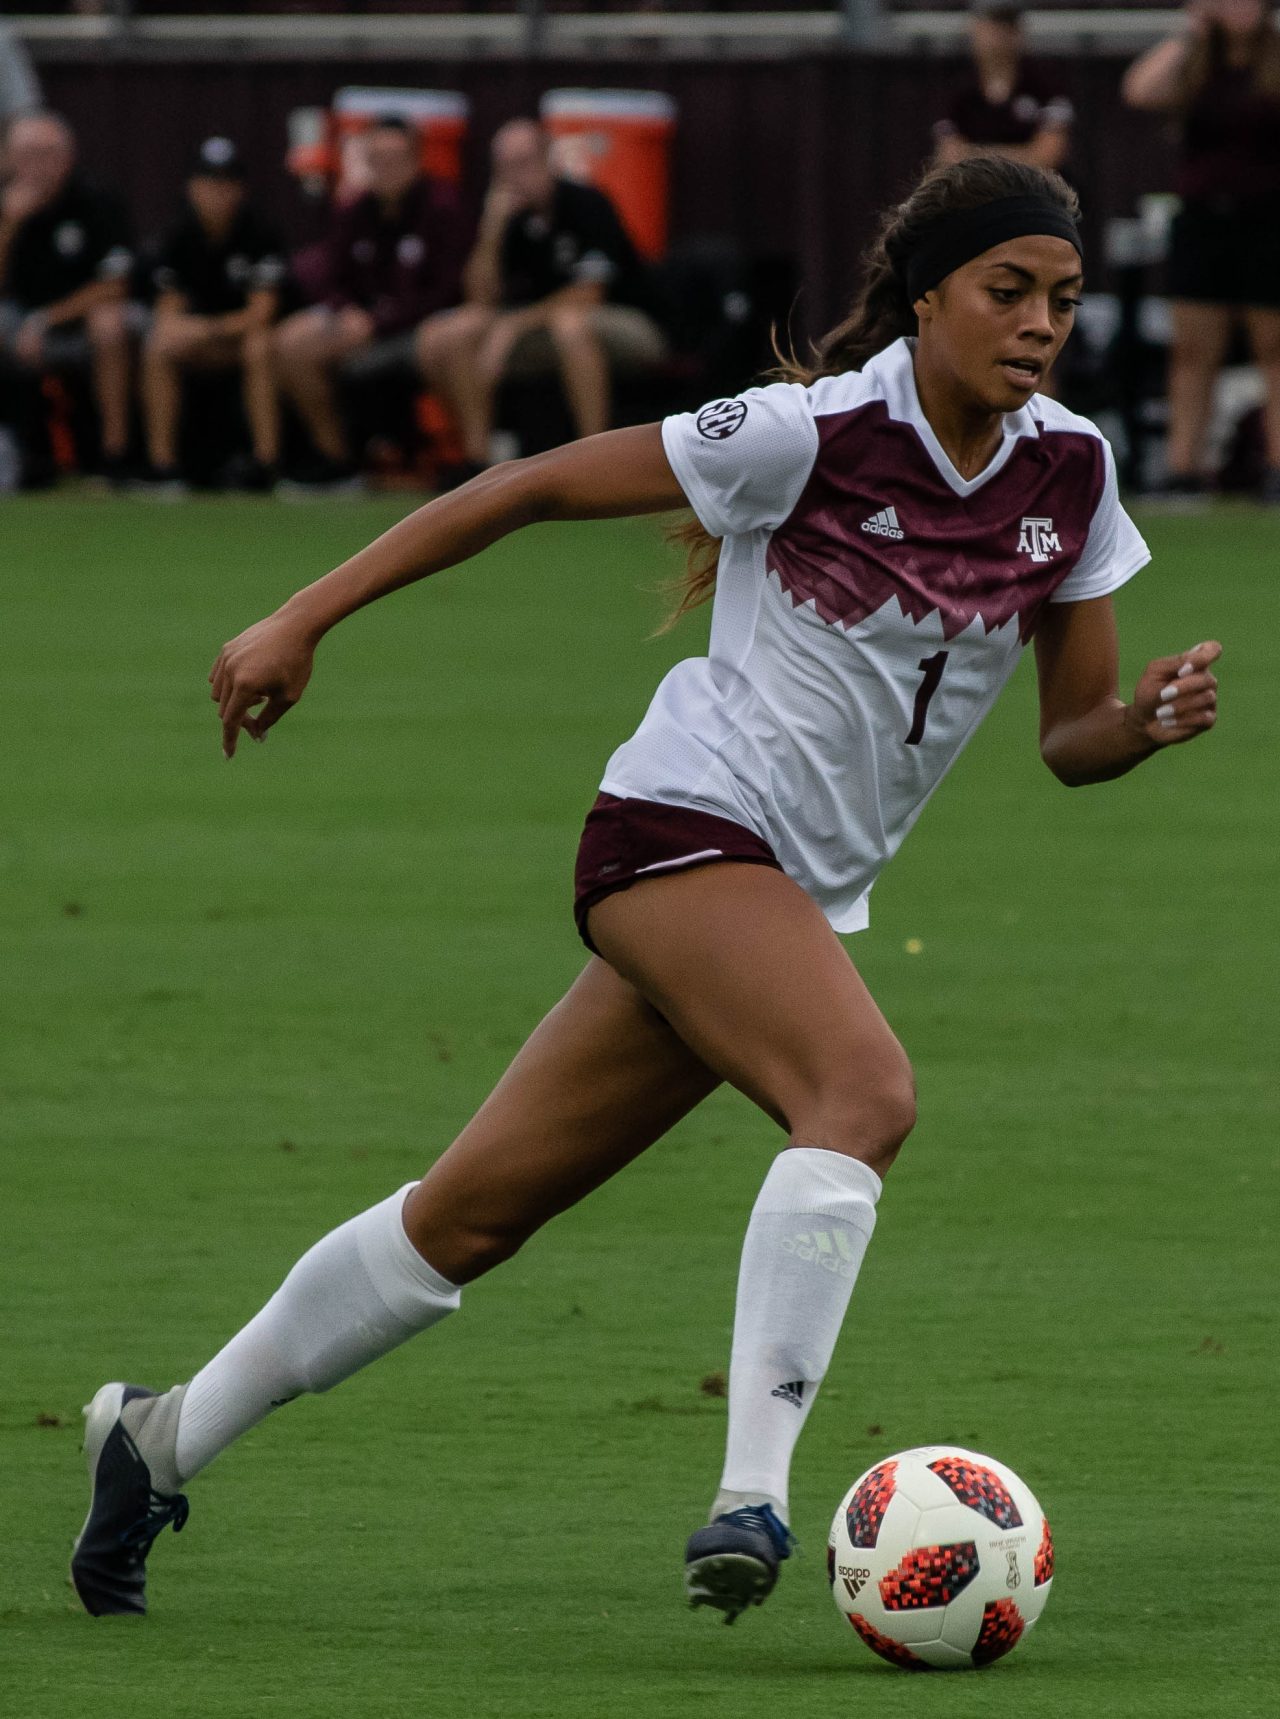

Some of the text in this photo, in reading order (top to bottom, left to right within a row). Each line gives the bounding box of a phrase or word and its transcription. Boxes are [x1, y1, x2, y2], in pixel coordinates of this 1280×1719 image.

[697, 400, 747, 440] SEC
[861, 522, 904, 539] adidas
[904, 650, 949, 745] 1
[838, 1565, 871, 1579] adidas
